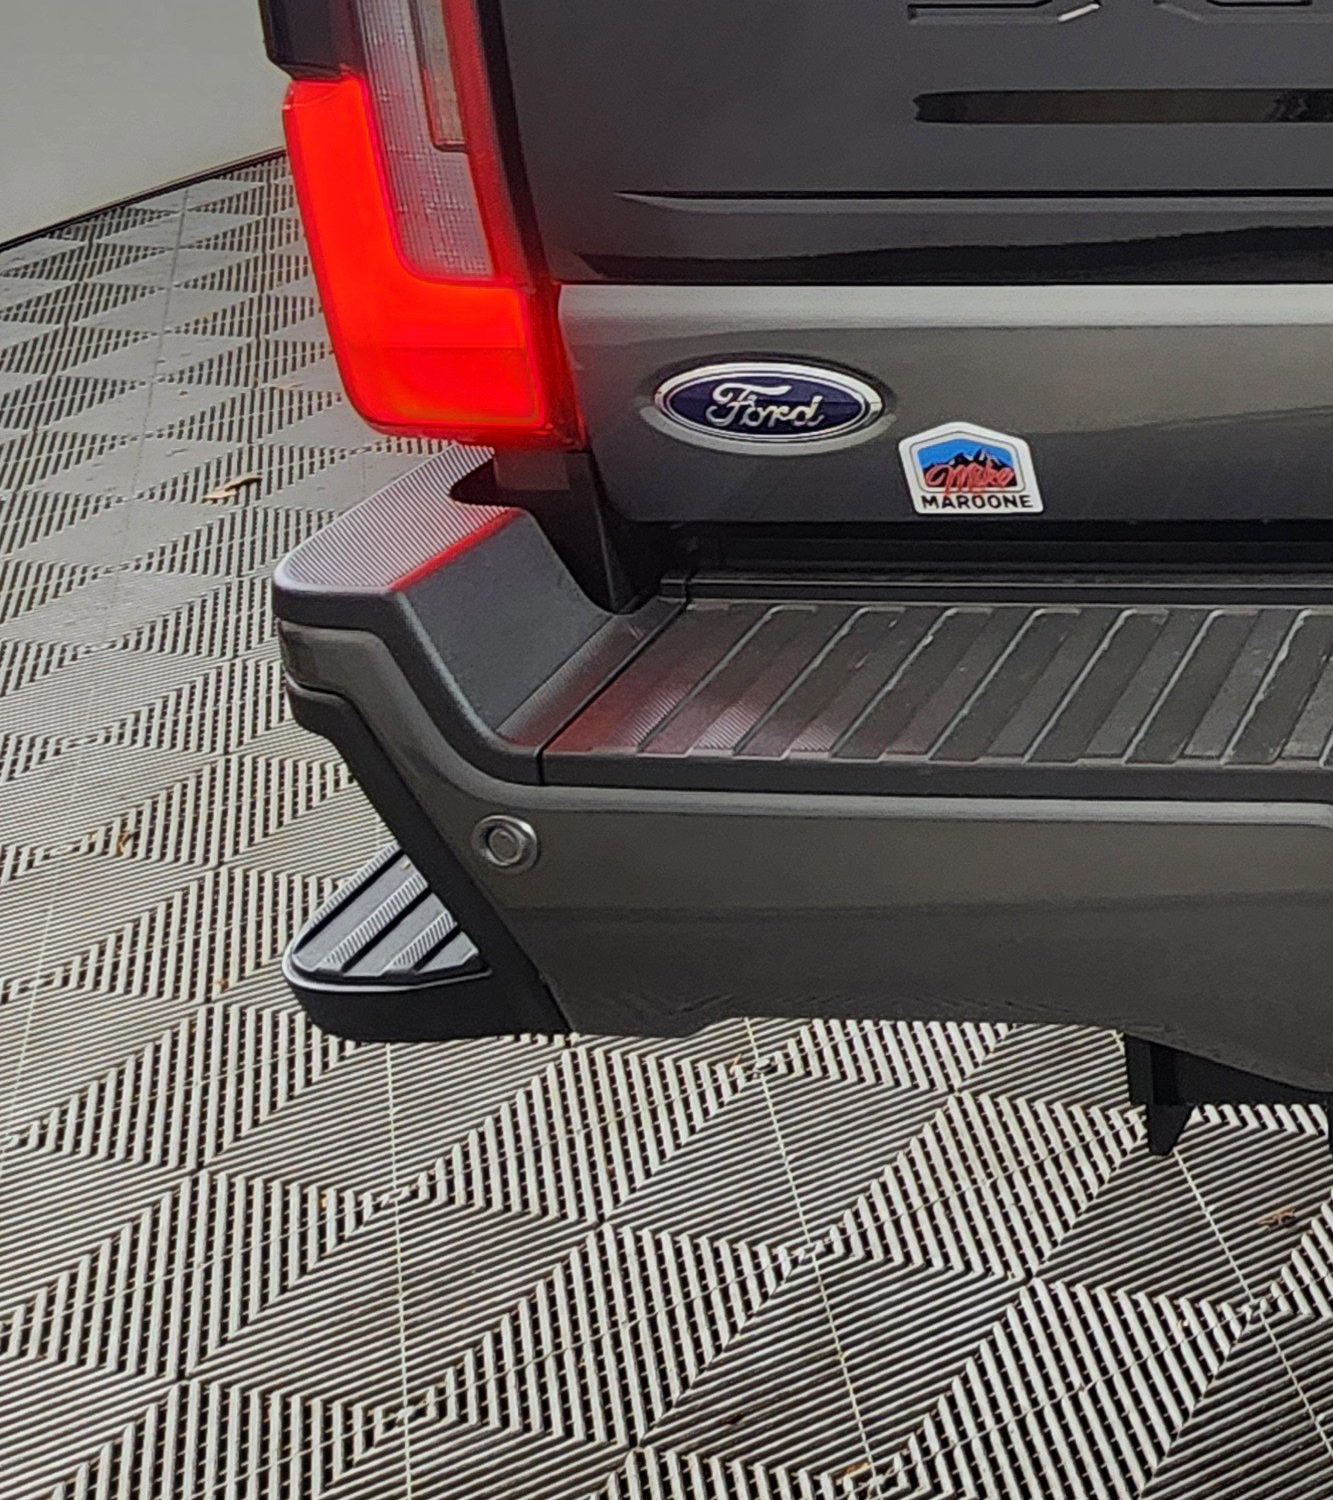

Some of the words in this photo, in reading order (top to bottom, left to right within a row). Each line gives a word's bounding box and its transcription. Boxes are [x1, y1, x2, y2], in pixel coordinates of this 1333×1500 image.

[705, 381, 826, 428] Ford
[924, 459, 1015, 498] Mike
[920, 493, 1034, 511] MAROONE
